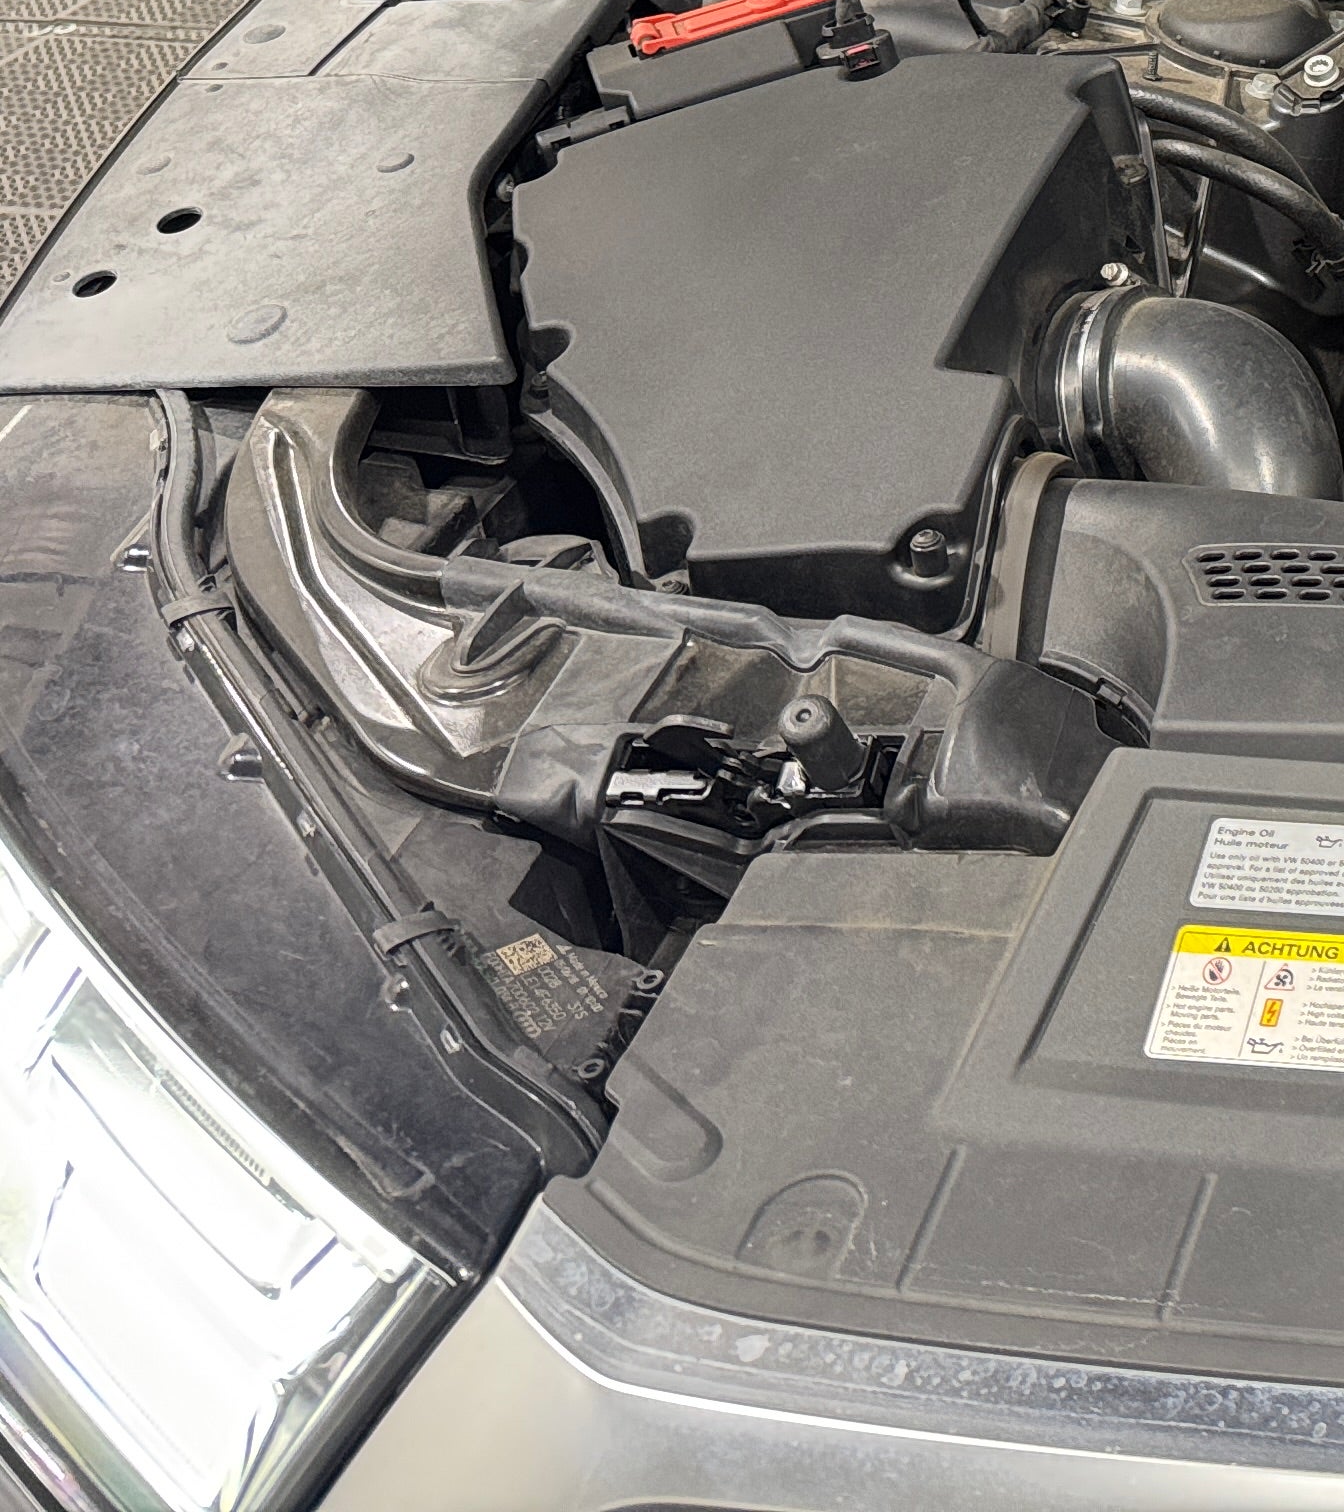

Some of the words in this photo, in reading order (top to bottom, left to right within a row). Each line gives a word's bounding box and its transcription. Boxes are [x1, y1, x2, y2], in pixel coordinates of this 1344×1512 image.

[1216, 826, 1256, 837] Engine
[1258, 828, 1275, 837] Oil
[1213, 837, 1242, 846] Huile
[1245, 840, 1289, 849] moteur
[1208, 851, 1227, 859] Use
[1227, 852, 1248, 861] only
[1261, 854, 1281, 863] with
[1282, 856, 1298, 864] VW
[1326, 858, 1336, 866] or
[1298, 868, 1339, 877] approved
[1200, 881, 1216, 889] VW
[1289, 877, 1306, 885] des
[1197, 891, 1217, 900] Pour
[1219, 892, 1236, 901] une
[1241, 941, 1340, 960] ACHTUNG
[1186, 1004, 1213, 1013] engine
[1169, 1010, 1199, 1020] Moving
[1305, 1010, 1325, 1018] High
